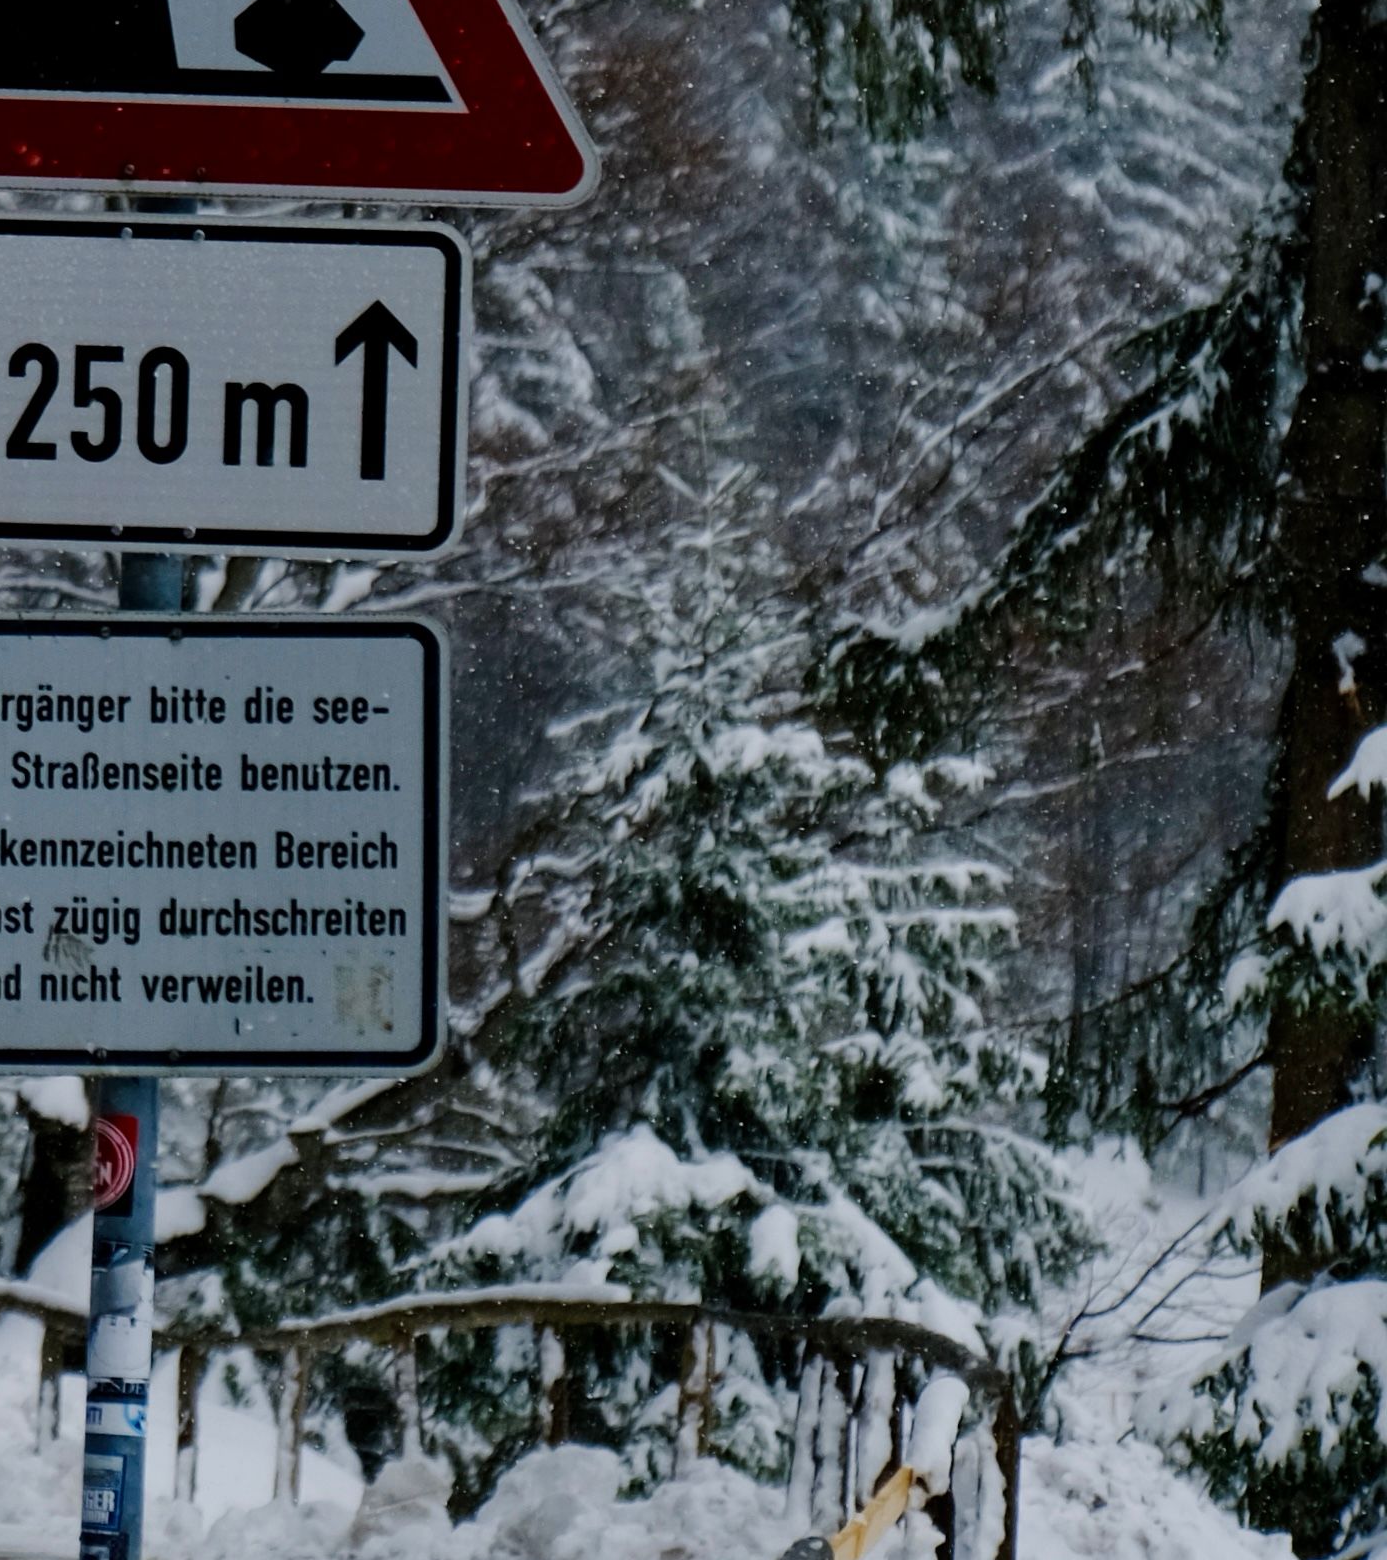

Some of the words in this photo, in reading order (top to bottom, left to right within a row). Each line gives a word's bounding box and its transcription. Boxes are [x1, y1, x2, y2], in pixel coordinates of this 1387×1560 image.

[4, 342, 191, 466] 250
[222, 381, 310, 469] m
[150, 685, 227, 725] bitte
[244, 685, 294, 725] die
[312, 695, 390, 725] see-
[11, 750, 223, 793] Straßenseite
[240, 753, 401, 792] benutzen.
[274, 830, 398, 870] Bereich
[53, 896, 141, 946] zügig
[159, 897, 407, 939] durchschreiten
[40, 965, 122, 1003] nicht
[141, 965, 314, 1004] verweilen.
